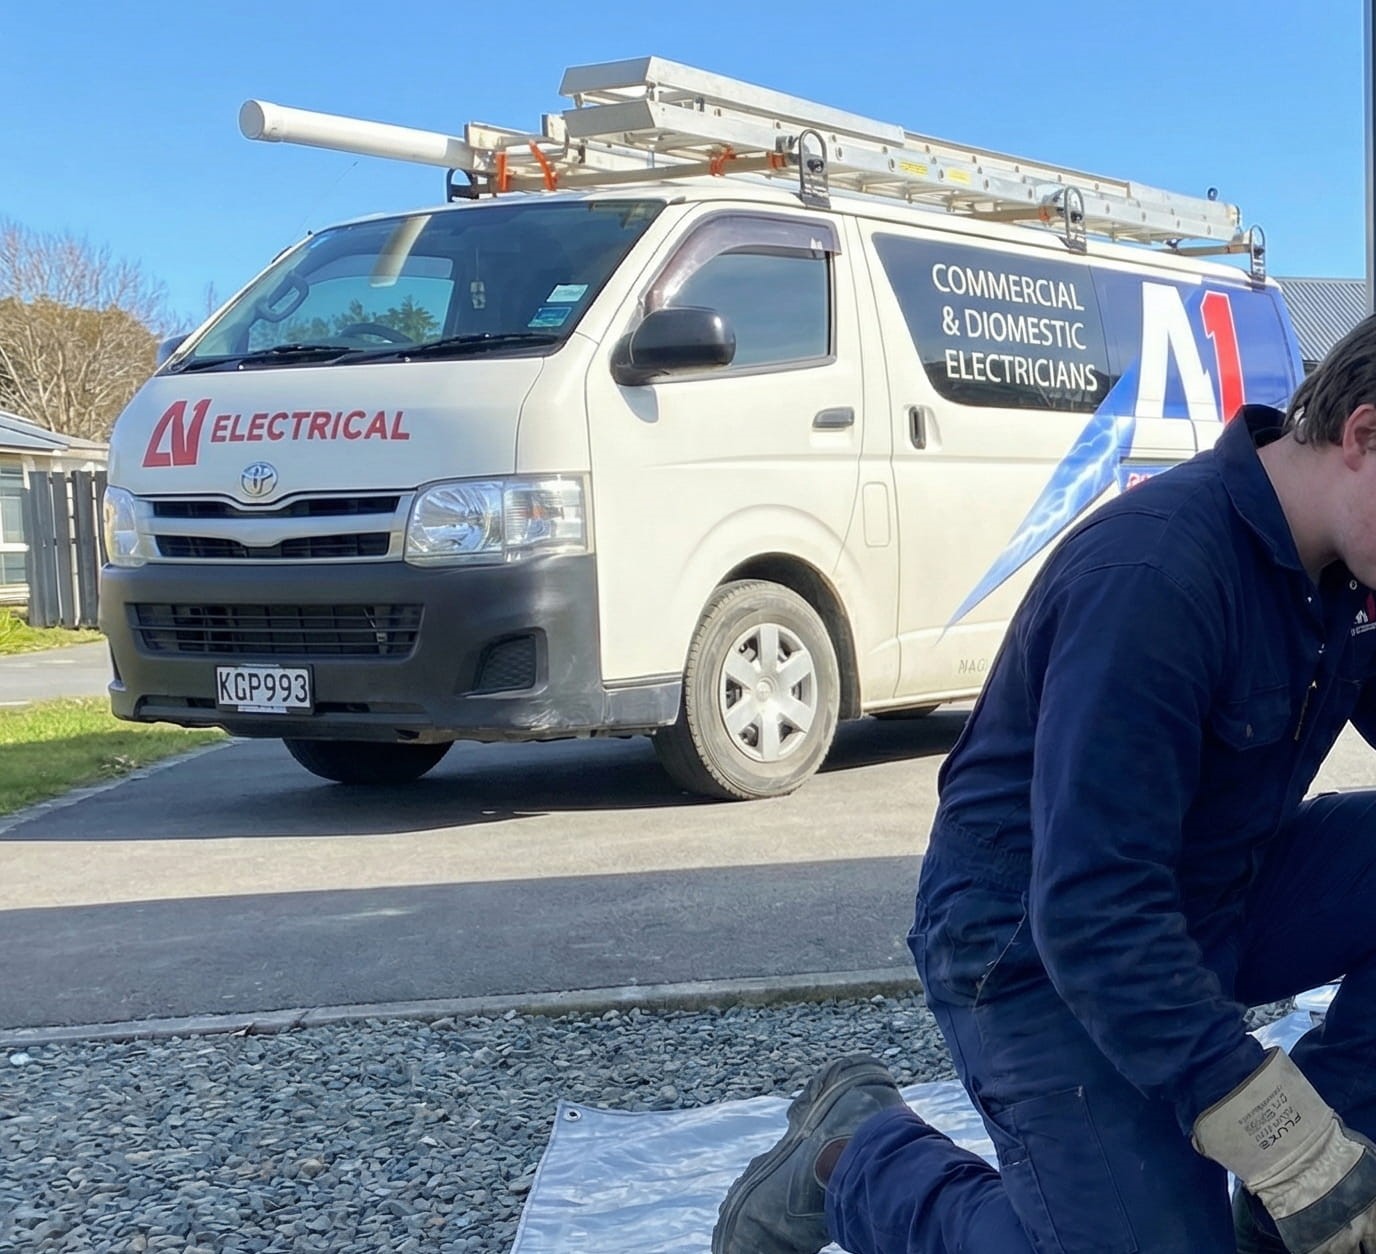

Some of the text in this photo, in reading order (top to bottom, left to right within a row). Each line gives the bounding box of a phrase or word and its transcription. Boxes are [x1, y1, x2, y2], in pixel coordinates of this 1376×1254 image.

[932, 263, 1085, 311] COMMERCIAL
[942, 305, 1087, 350] & DIOMESTIC
[945, 349, 1098, 392] ELECTRICIANS
[210, 410, 412, 443] ELECTRICAL
[219, 671, 308, 703] KGP993
